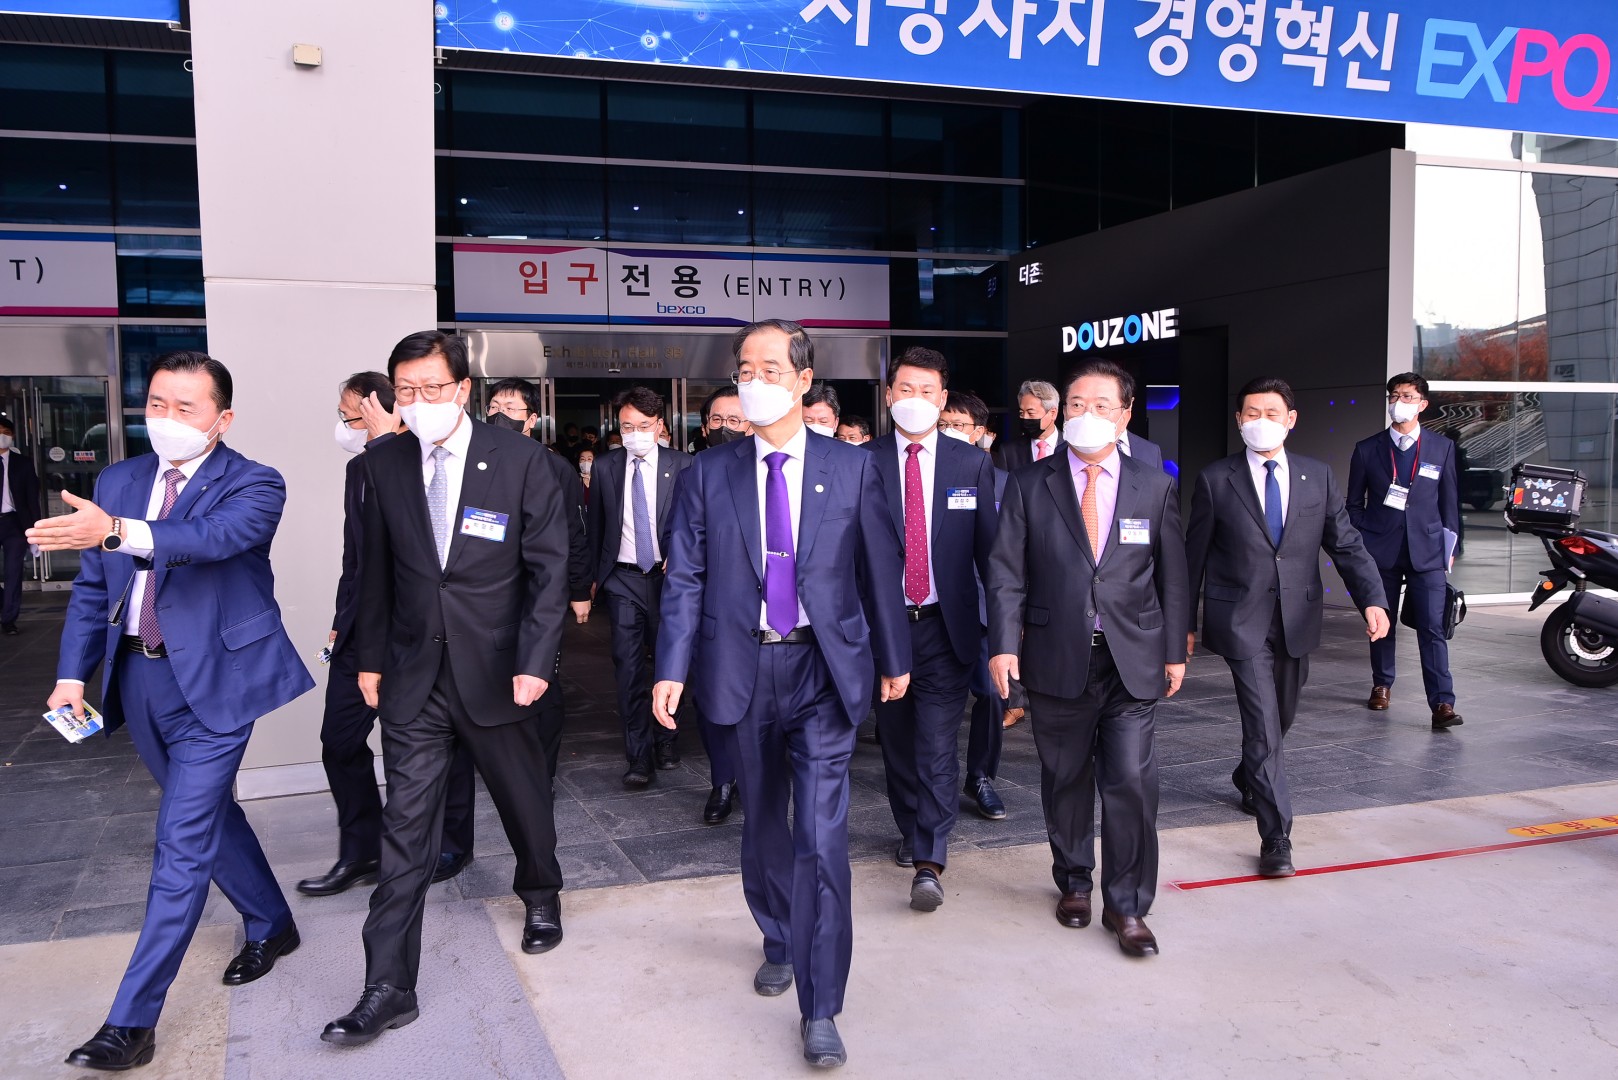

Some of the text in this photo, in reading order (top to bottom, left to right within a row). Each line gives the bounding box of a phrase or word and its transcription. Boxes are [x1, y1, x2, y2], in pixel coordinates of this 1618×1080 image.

[1134, 0, 1399, 92] 경영혁신
[1416, 18, 1618, 114] EXPO
[518, 260, 846, 301] 입구 전용 (ENTRY)
[1018, 262, 1043, 286] 더존
[656, 302, 706, 315] bexco
[1061, 307, 1179, 353] DOUZONE
